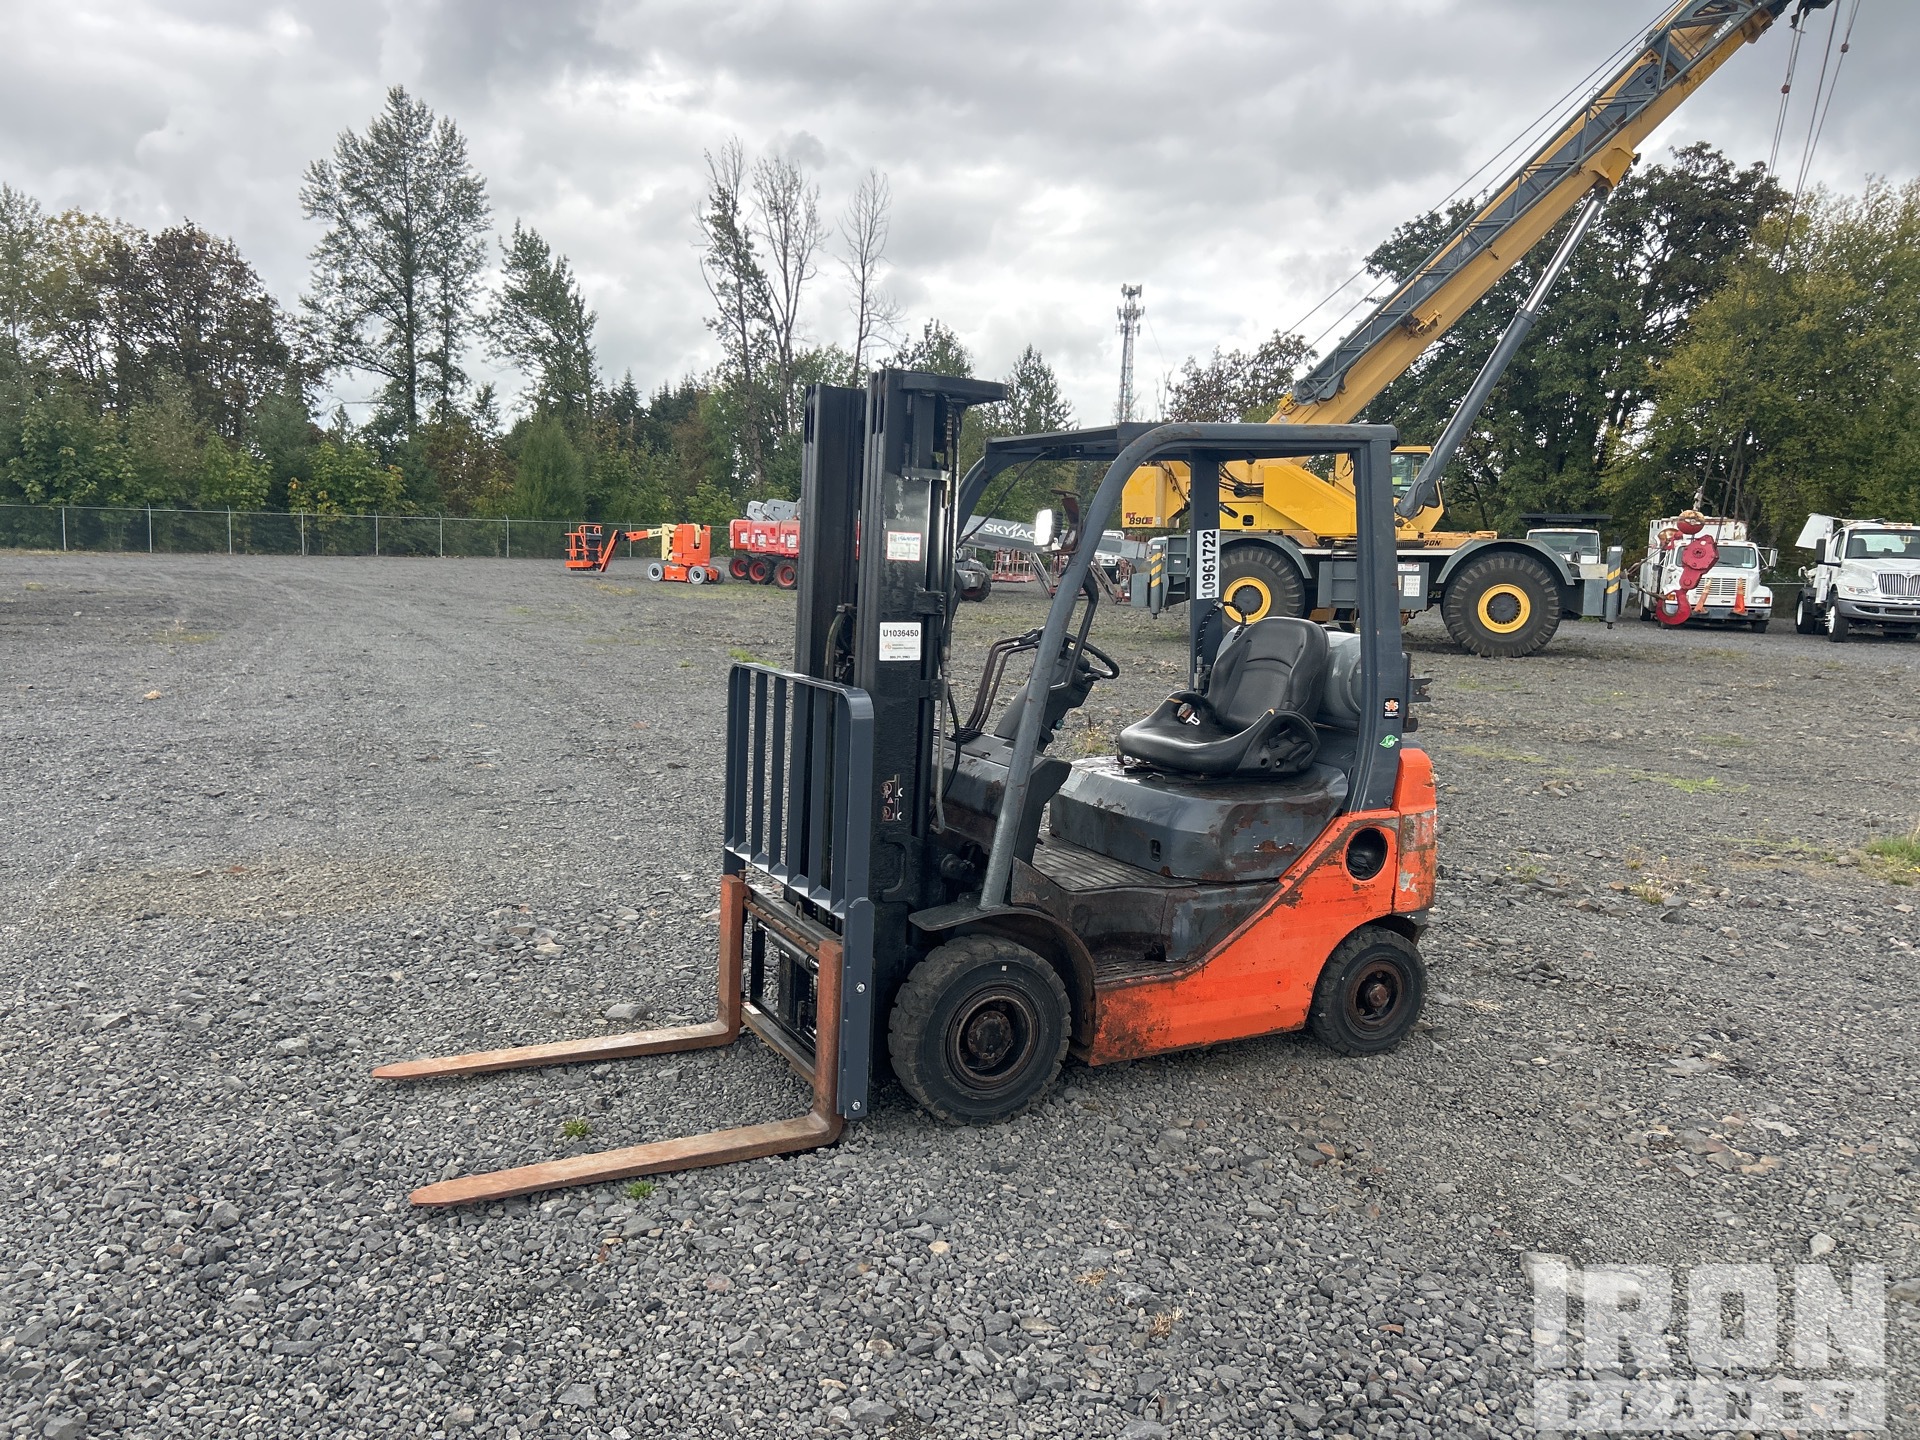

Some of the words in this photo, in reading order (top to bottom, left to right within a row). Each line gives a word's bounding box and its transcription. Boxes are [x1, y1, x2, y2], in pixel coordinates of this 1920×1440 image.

[1128, 516, 1154, 525] 890E
[984, 522, 1035, 540] SKYJAC
[1201, 530, 1217, 598] 10961722
[882, 629, 919, 637] U1036450
